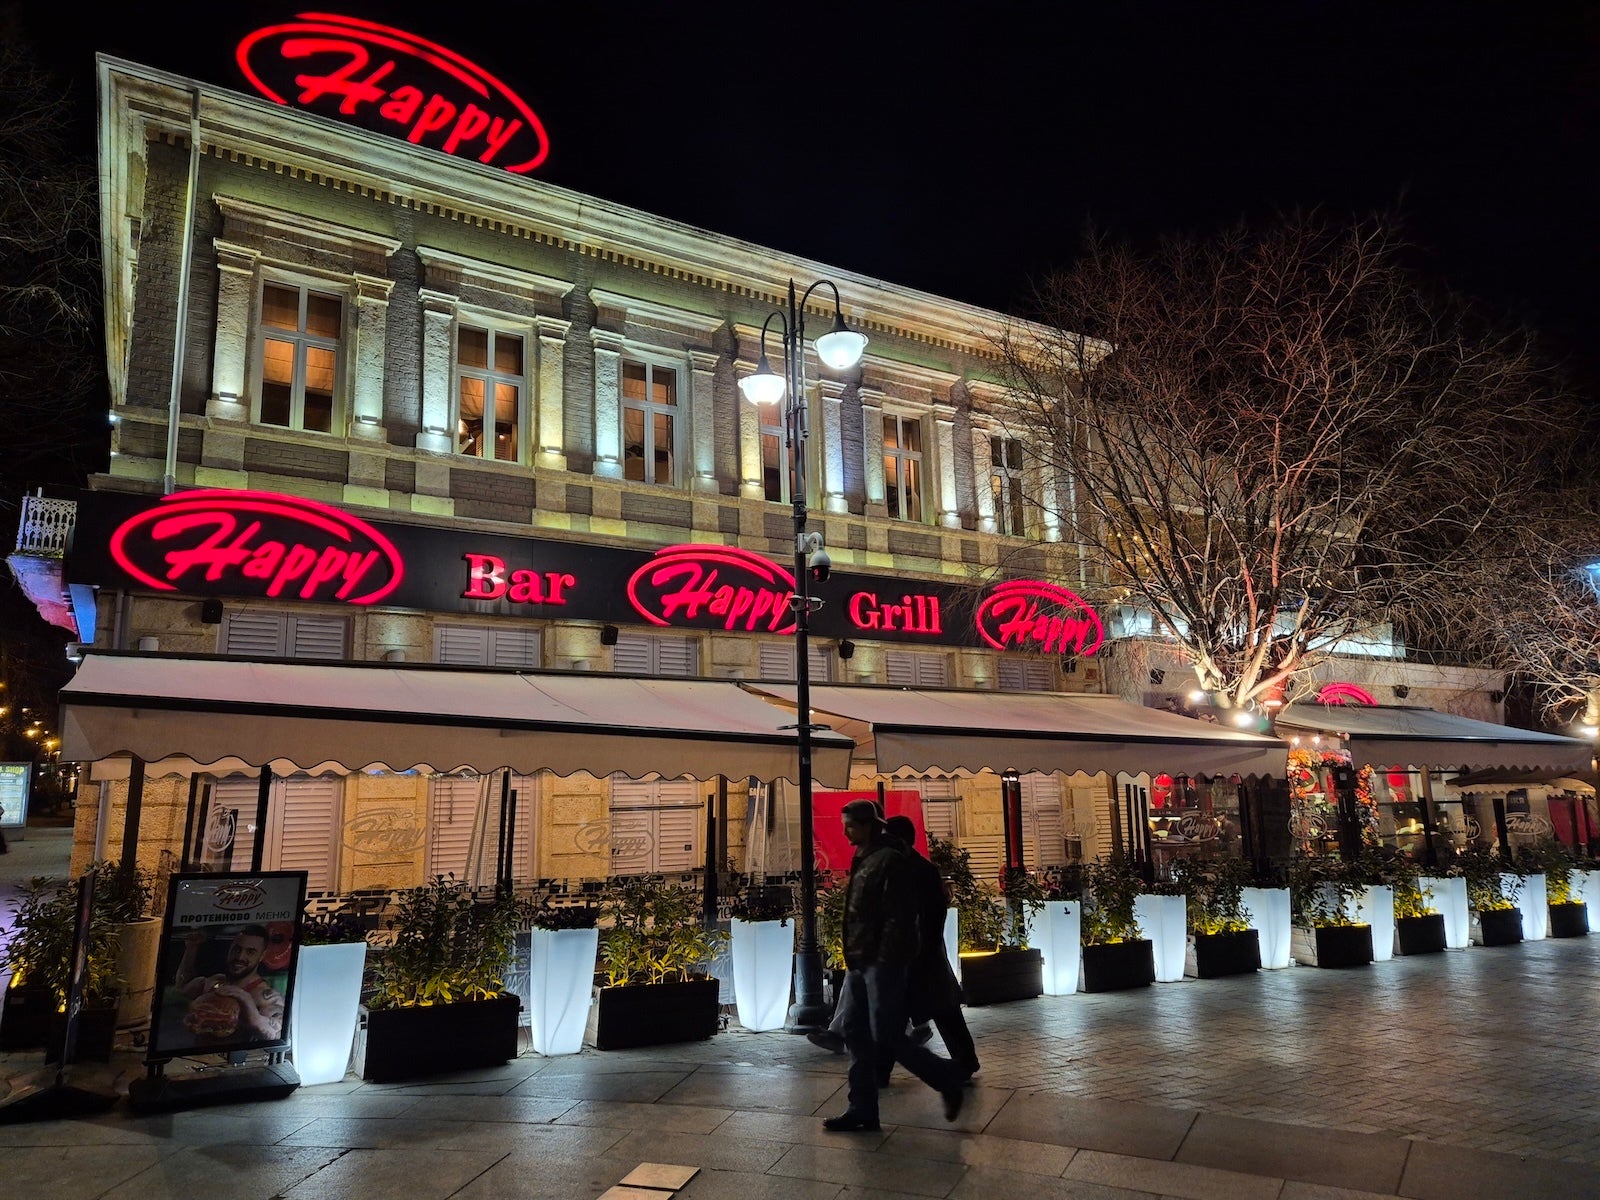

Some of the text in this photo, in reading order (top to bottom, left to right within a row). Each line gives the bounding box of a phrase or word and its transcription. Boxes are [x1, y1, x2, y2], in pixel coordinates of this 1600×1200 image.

[281, 38, 523, 164] Happy
[151, 512, 1092, 654] Happy Bar Happy Grill Happy
[350, 818, 427, 849] Happy
[1182, 817, 1213, 837] Happy
[255, 911, 290, 920] МЕНЮ
